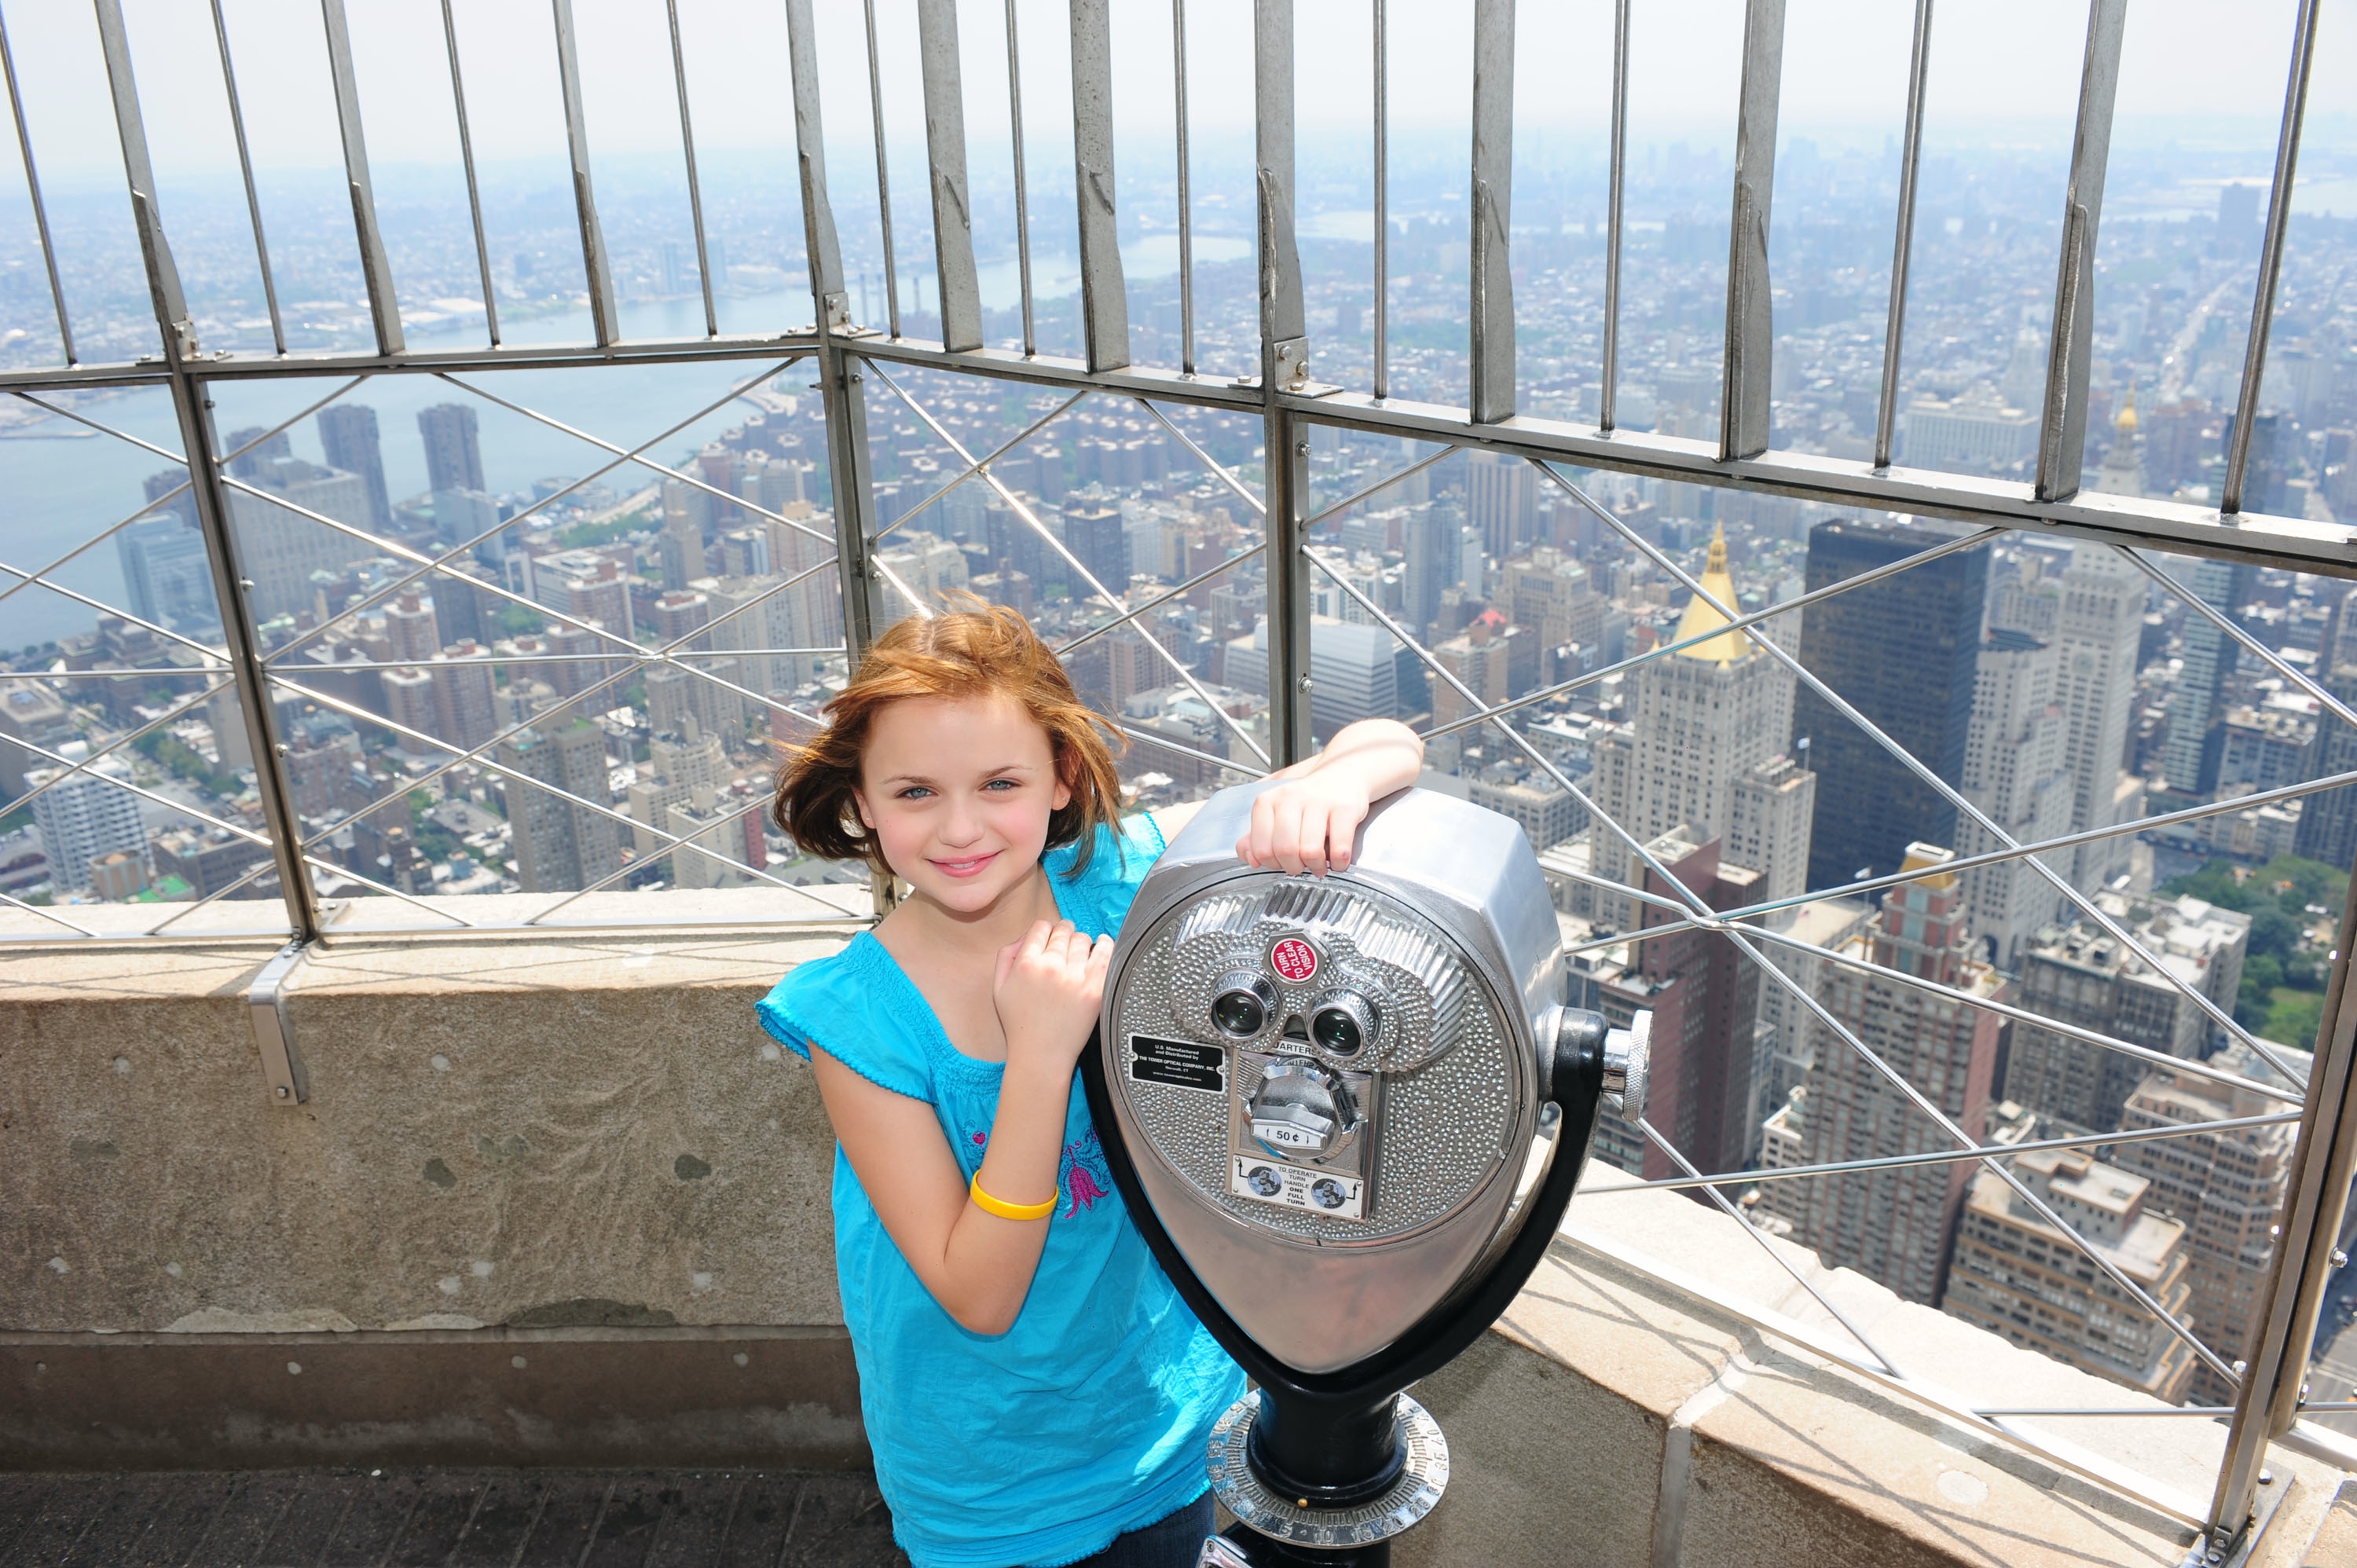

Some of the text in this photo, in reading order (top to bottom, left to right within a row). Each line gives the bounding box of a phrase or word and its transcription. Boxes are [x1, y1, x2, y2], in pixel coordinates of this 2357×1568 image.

[1277, 951, 1292, 973] TURN
[1283, 941, 1305, 979] TO CLEAR
[1296, 944, 1313, 971] VISION
[1166, 1046, 1199, 1055] Manufactured
[1273, 1042, 1316, 1056] UARTERS
[1288, 1168, 1317, 1178] OPERATE
[1284, 1180, 1310, 1189] HANDLE
[1434, 1452, 1448, 1471] 35
[1382, 1517, 1405, 1536] 20
[1314, 1528, 1334, 1544] 10
